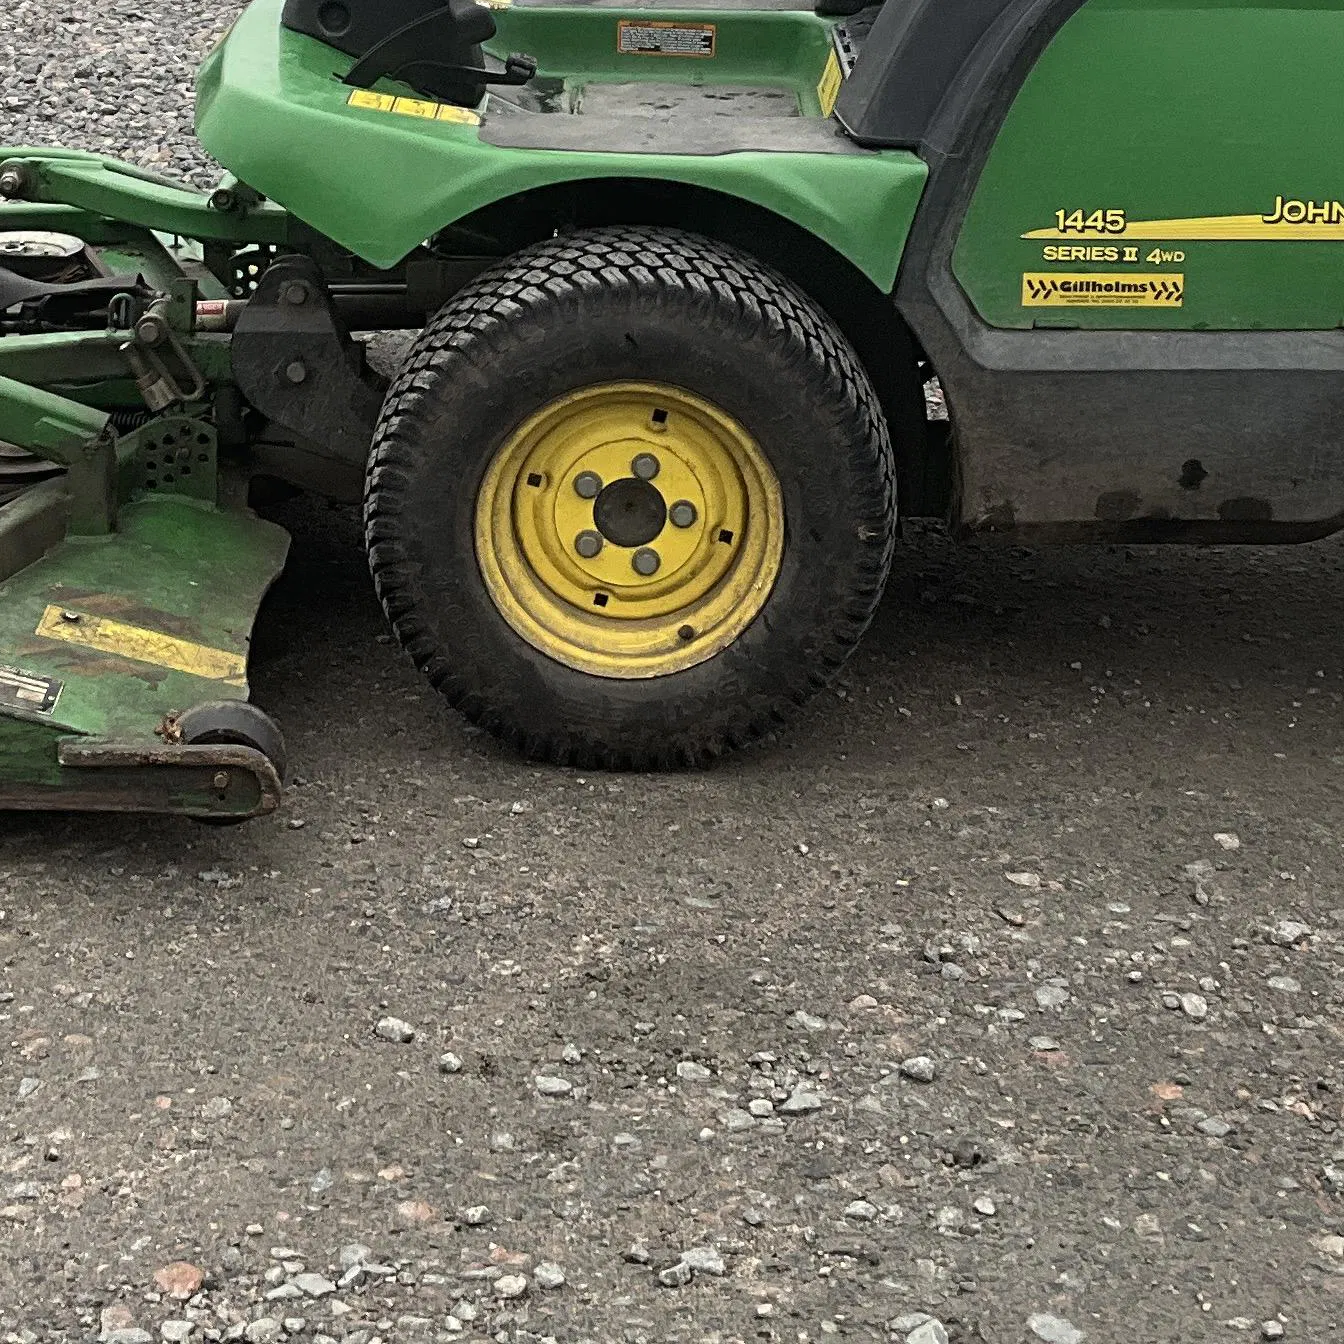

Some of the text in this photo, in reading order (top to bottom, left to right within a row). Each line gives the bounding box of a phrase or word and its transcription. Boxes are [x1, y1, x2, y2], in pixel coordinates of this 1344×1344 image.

[1055, 208, 1127, 234] 1445
[1042, 245, 1120, 263] SERIES
[1145, 248, 1186, 265] 4WD
[1058, 280, 1149, 294] Gillholms
